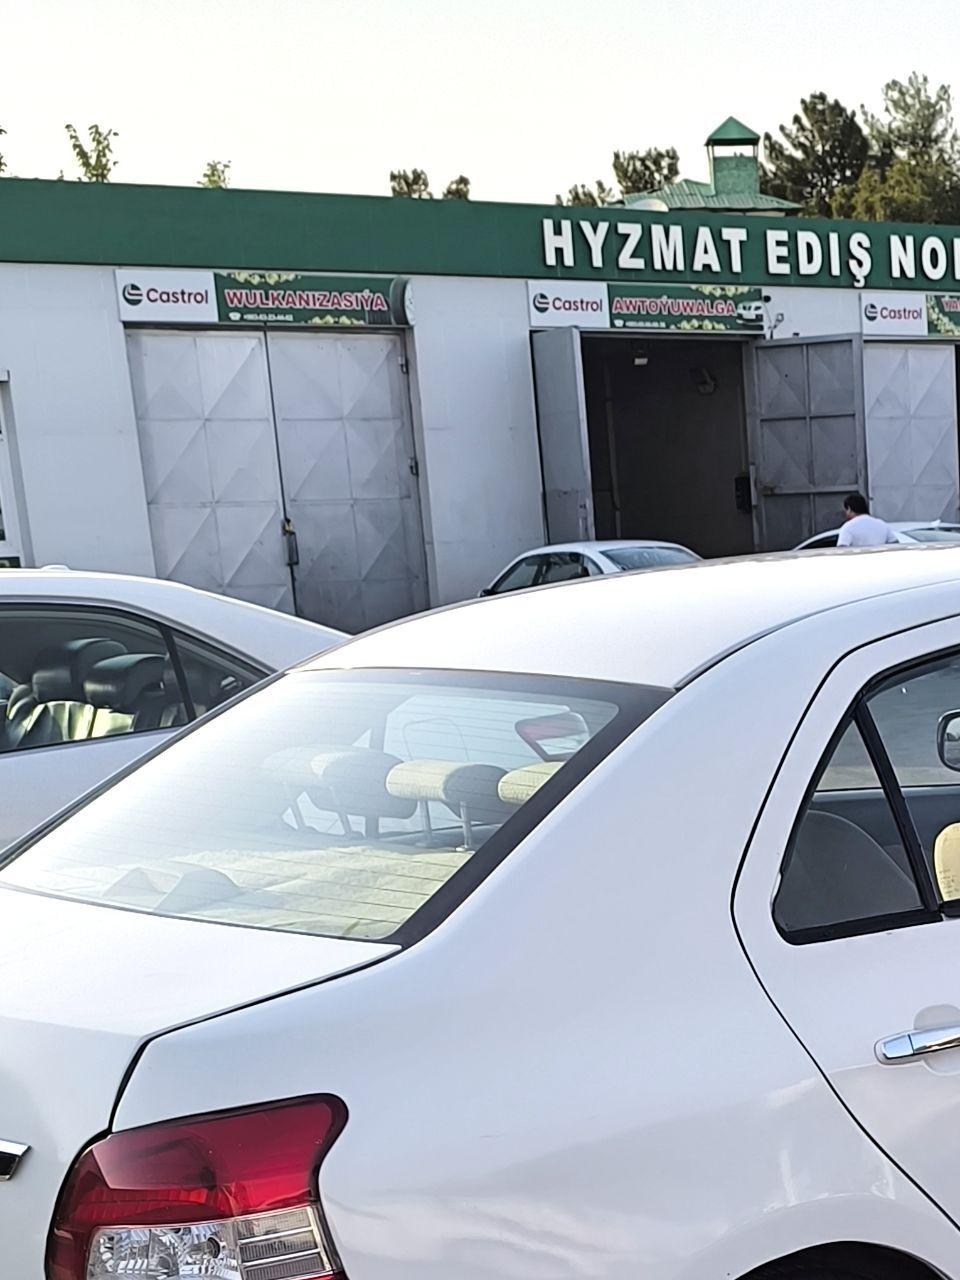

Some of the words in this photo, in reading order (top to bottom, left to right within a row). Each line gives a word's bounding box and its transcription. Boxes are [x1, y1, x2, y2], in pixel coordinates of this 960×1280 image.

[543, 218, 748, 273] HYZMAT
[766, 229, 872, 288] EDIŞ
[146, 287, 208, 305] Castrol
[552, 297, 603, 313] Castrol
[612, 295, 737, 316] AWTOÝUWALGA
[880, 307, 922, 320] Castrol
